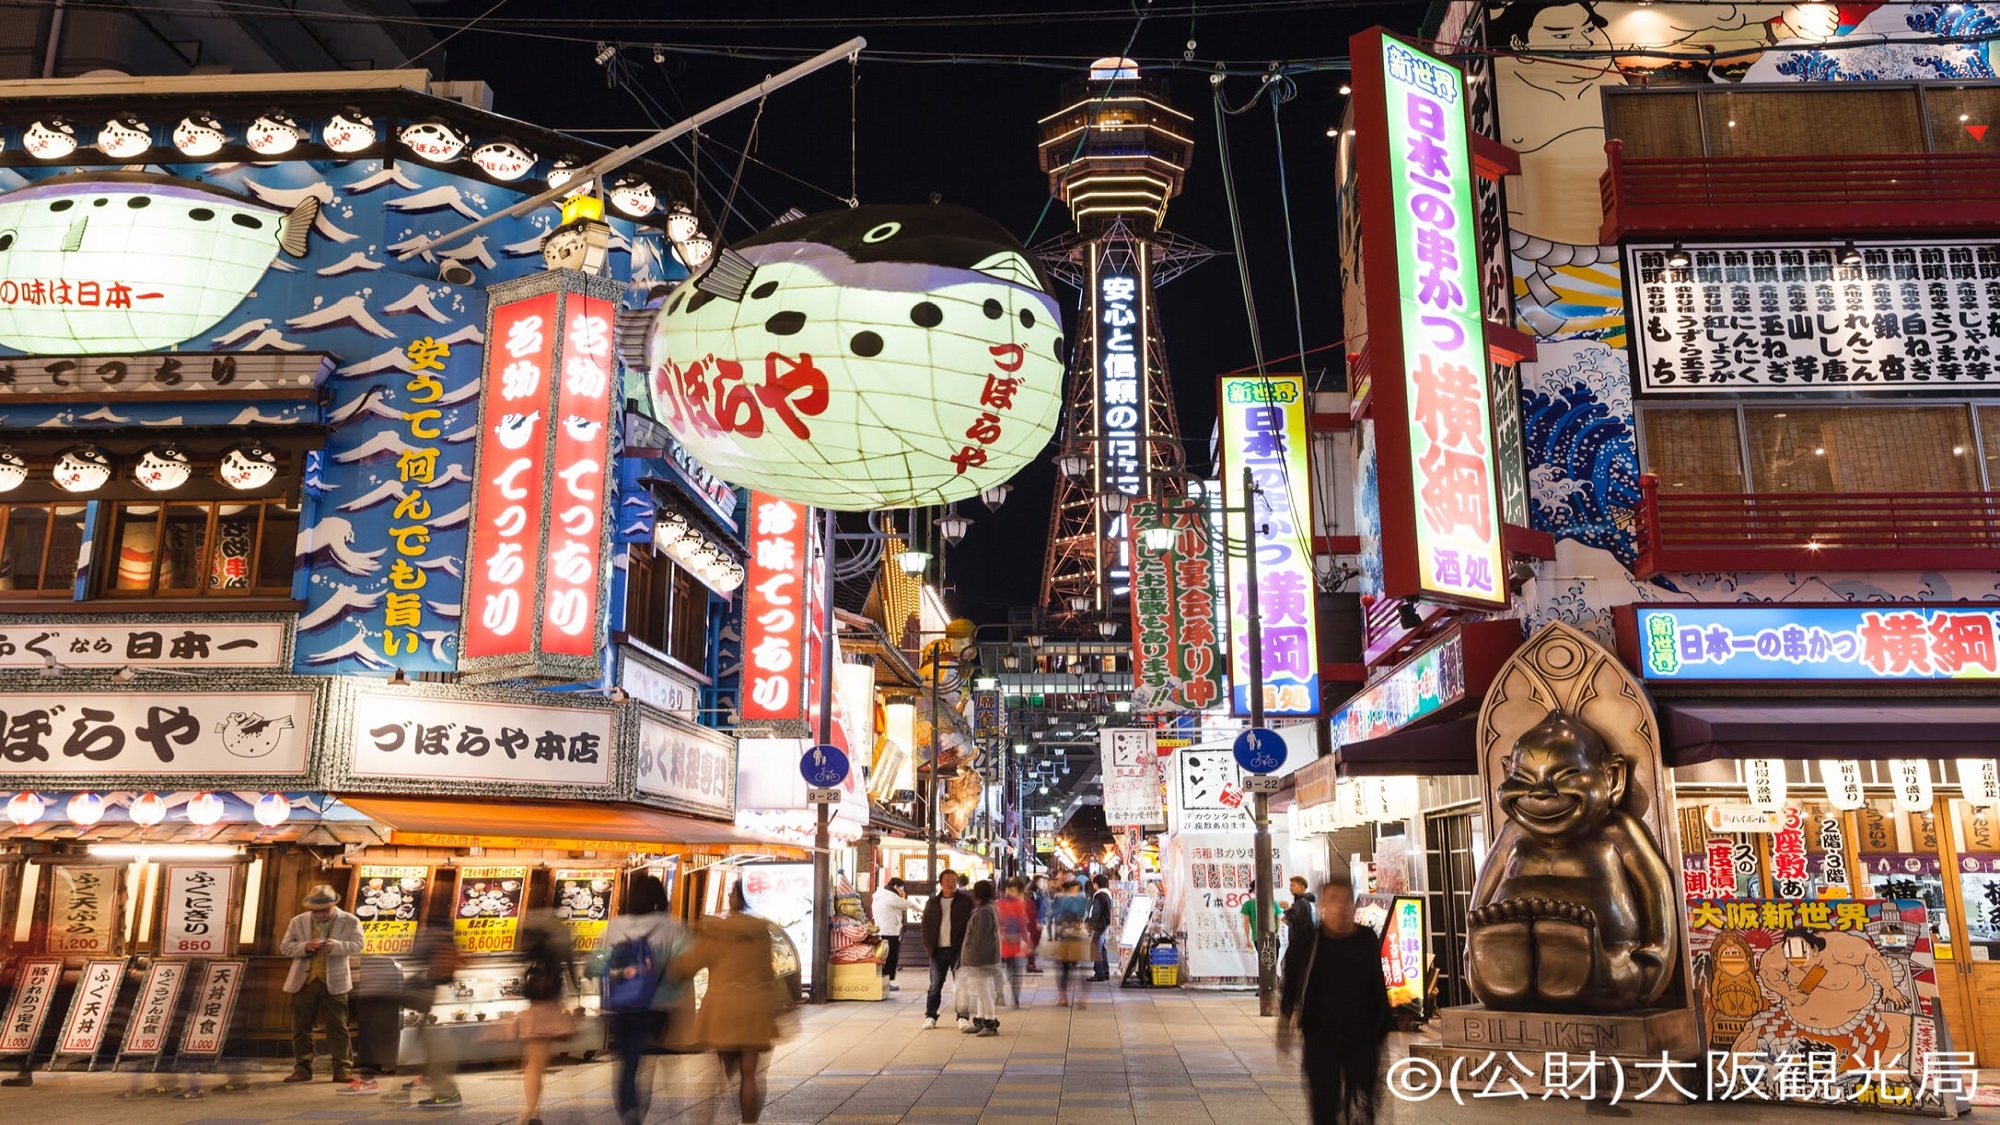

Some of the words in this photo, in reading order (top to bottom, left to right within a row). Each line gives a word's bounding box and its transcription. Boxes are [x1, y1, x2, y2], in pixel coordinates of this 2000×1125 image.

[1387, 44, 1458, 103] 新世界
[1406, 92, 1464, 351] 日本一の串かつ
[1640, 251, 1667, 284] 前頭
[1696, 251, 1723, 283] 前頭
[1723, 251, 1751, 283] 前頭
[1751, 250, 1779, 283] 前頭
[1779, 250, 1807, 283] 前頭
[1807, 249, 1835, 282] 前頭
[1863, 248, 1892, 280] 前頭
[1891, 248, 1920, 280] 前頭
[1920, 247, 1948, 280] 前頭
[1948, 247, 1977, 280] 前頭
[501, 314, 544, 401] 名物
[566, 314, 609, 399] 名物
[1647, 316, 1676, 384] もち
[1676, 316, 1707, 383] うずら玉子
[1702, 315, 1736, 383] 紅しょうが
[1730, 316, 1761, 383] にんにく
[1759, 315, 1791, 382] 玉ねぎ
[1787, 314, 1819, 382] 山芋
[1817, 314, 1848, 382] しし唐
[1844, 313, 1878, 381] れんこん
[1872, 312, 1905, 381] 銀杏
[1902, 312, 1934, 381] 白ねぎ
[1931, 311, 1963, 380] さつま芋
[1959, 311, 1992, 380] じゃが芋
[656, 350, 830, 441] づぼらや
[950, 342, 1029, 475] づぼらや
[1227, 381, 1298, 403] 新世界
[1412, 354, 1493, 544] 横綱
[383, 336, 450, 656] 安うて何んでも旨い
[482, 458, 533, 636] てっちり
[548, 459, 600, 636] てっちり
[1432, 546, 1493, 593] 酒処
[752, 500, 798, 712] 珍味てっちり
[1131, 502, 1171, 708] 広々したお座敷もあります!!
[1236, 570, 1309, 681] 横綱
[1650, 615, 1677, 673] 新世界
[1679, 624, 1857, 661] 日本一の串かつ
[1861, 613, 1998, 673] 横綱
[975, 692, 996, 727] 麻雀
[1246, 685, 1311, 712] 酒処
[369, 719, 602, 765] づぼらや本店
[66, 872, 101, 935] ふぐ天ぷら
[184, 870, 216, 936] ふぐにぎり
[1692, 900, 1872, 932] 大阪新世界
[178, 940, 211, 951] 850
[366, 939, 412, 952] 5,400円
[468, 935, 513, 951] 8,600円
[14, 966, 50, 1034] 豚ひれかつ定食
[77, 968, 111, 1034] ふぐ天丼
[142, 967, 176, 1034] ふぐうどん定食
[199, 968, 230, 1035] 天丼定食
[1463, 1017, 1620, 1049] BILLIKEN
